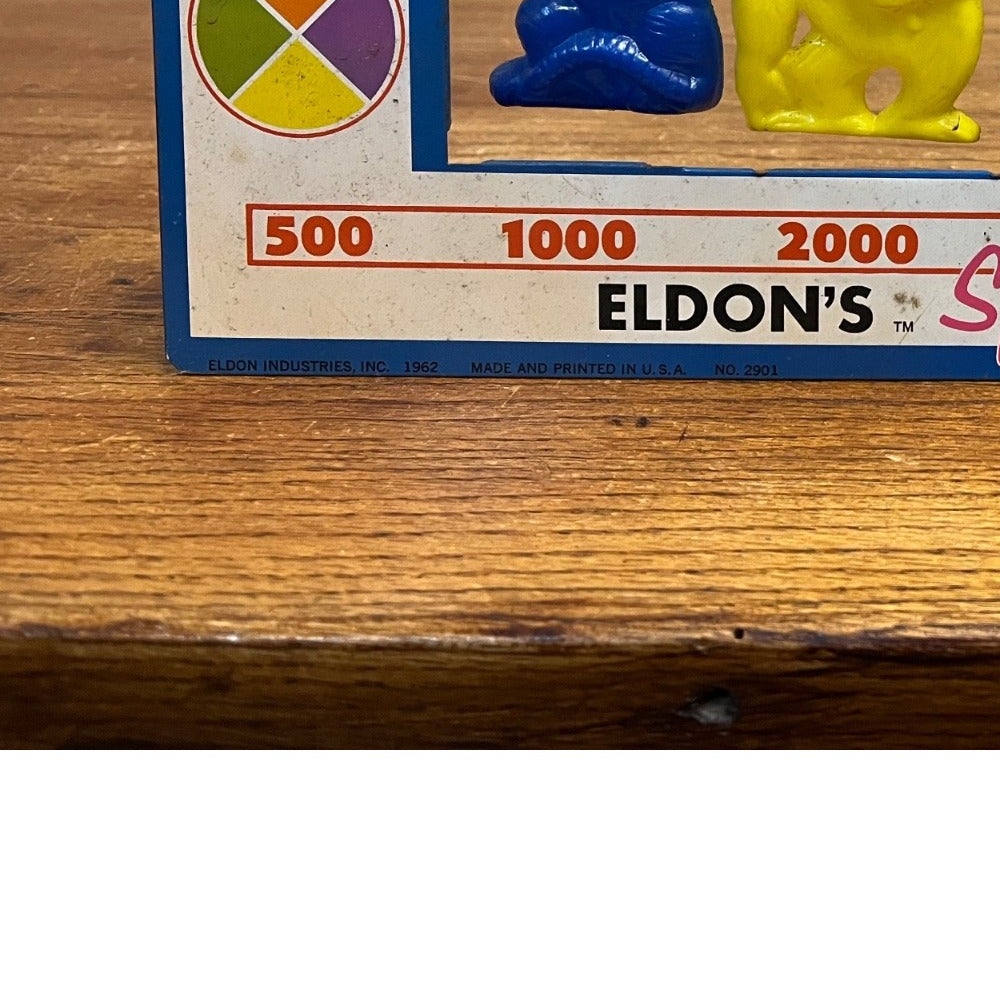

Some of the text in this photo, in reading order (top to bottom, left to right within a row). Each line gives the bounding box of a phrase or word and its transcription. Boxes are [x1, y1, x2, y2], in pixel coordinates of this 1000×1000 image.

[265, 215, 373, 257] 500
[501, 219, 636, 260] 1000
[777, 221, 918, 264] 2000
[598, 283, 874, 333] ELDON'S
[208, 360, 438, 375] ELDON INDUSTRIES, INC. 1962
[471, 362, 513, 374] MADE
[518, 363, 548, 375] AND
[553, 363, 616, 376] PRINTED
[621, 364, 637, 376] IN
[714, 365, 779, 378] NO. 2901
